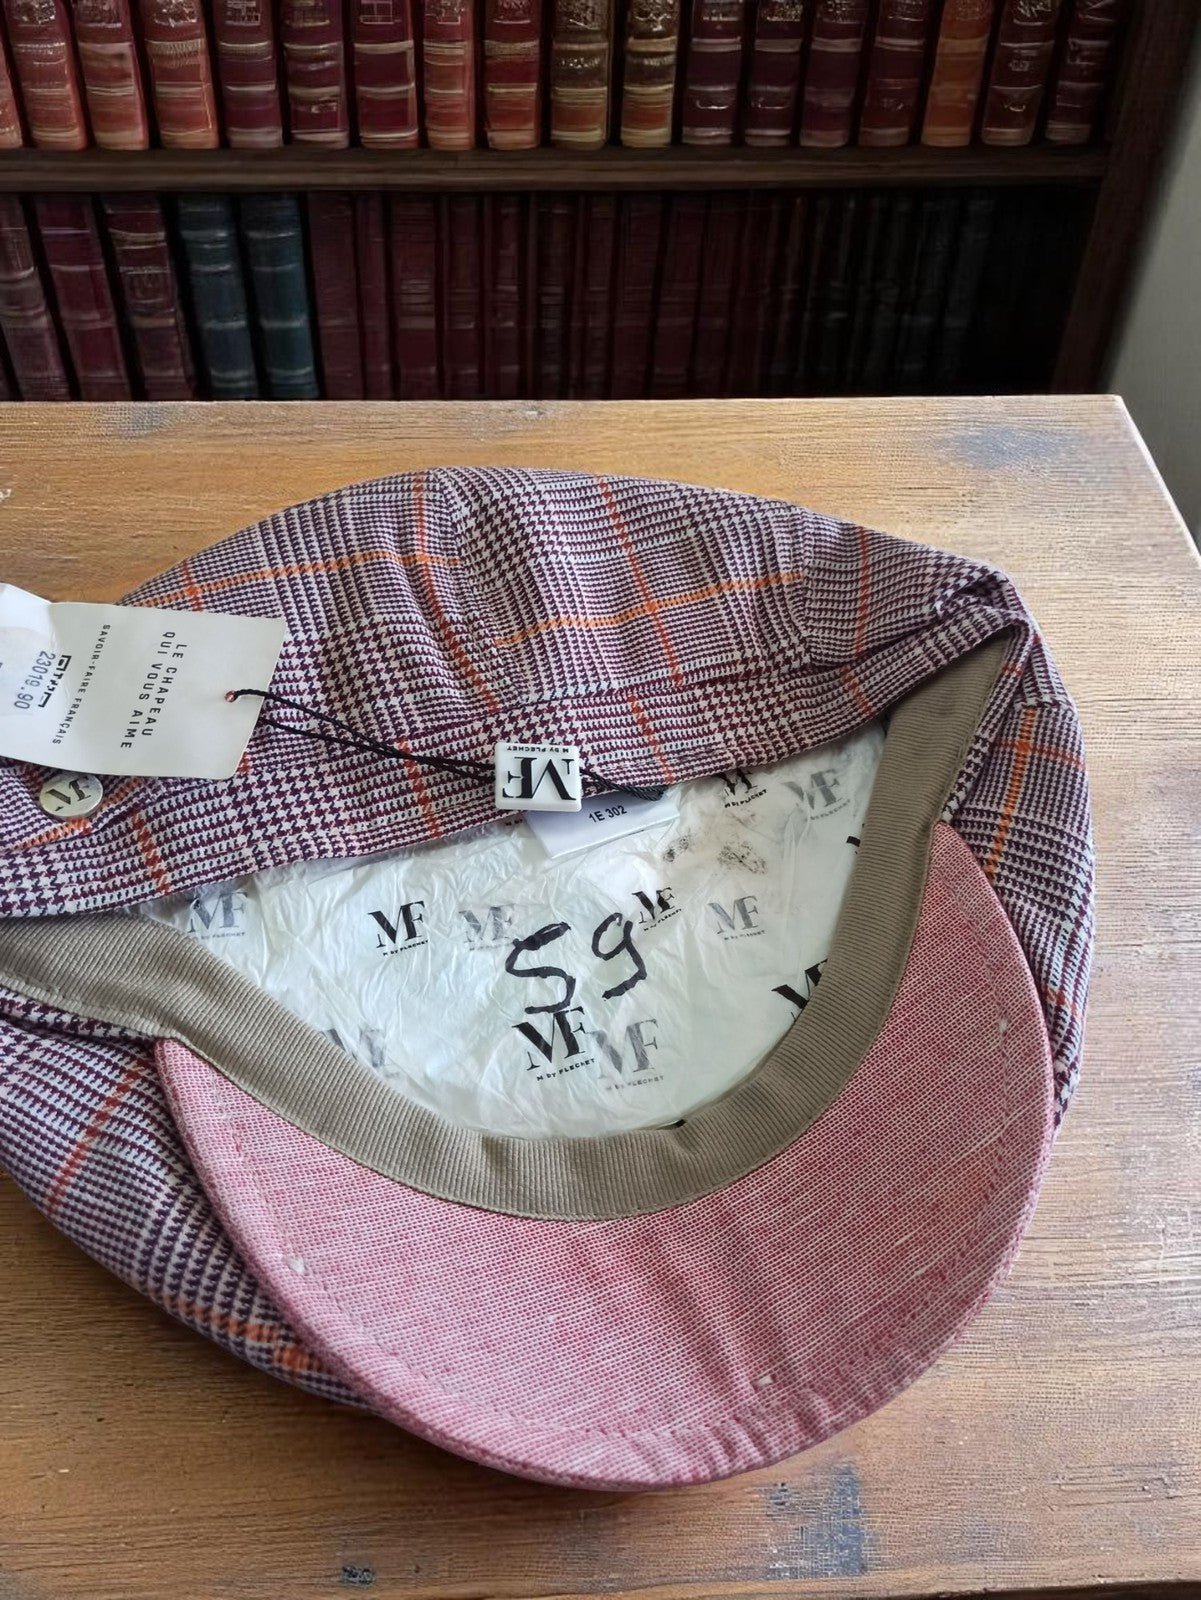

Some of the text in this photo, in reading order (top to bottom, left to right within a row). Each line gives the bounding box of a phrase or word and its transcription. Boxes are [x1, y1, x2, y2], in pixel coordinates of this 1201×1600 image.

[77, 624, 111, 694] SAVOIR-FAIRE
[120, 631, 176, 749] QUI VOUS AIME
[141, 643, 188, 737] LE CHAPEAU
[52, 696, 82, 745] FRANÇAIS
[502, 757, 576, 801] MF
[588, 804, 627, 825] 1E 302
[368, 900, 424, 948] MF
[512, 1005, 585, 1071] MF
